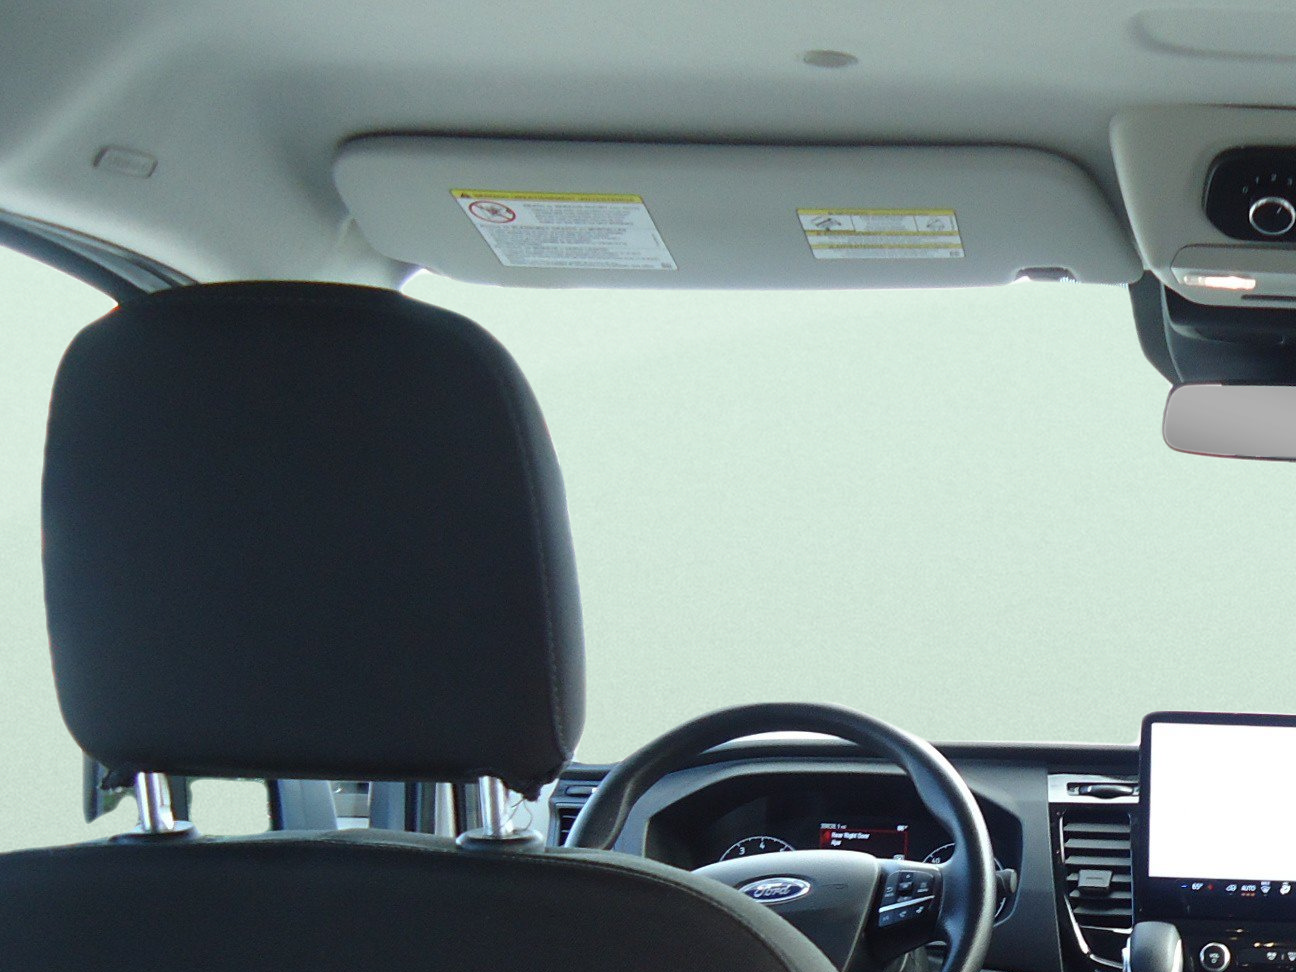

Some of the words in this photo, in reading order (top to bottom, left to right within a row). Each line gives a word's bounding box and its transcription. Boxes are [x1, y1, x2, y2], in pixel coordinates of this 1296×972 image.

[759, 842, 766, 850] 4
[738, 847, 746, 855] 3
[754, 883, 791, 898] Ford
